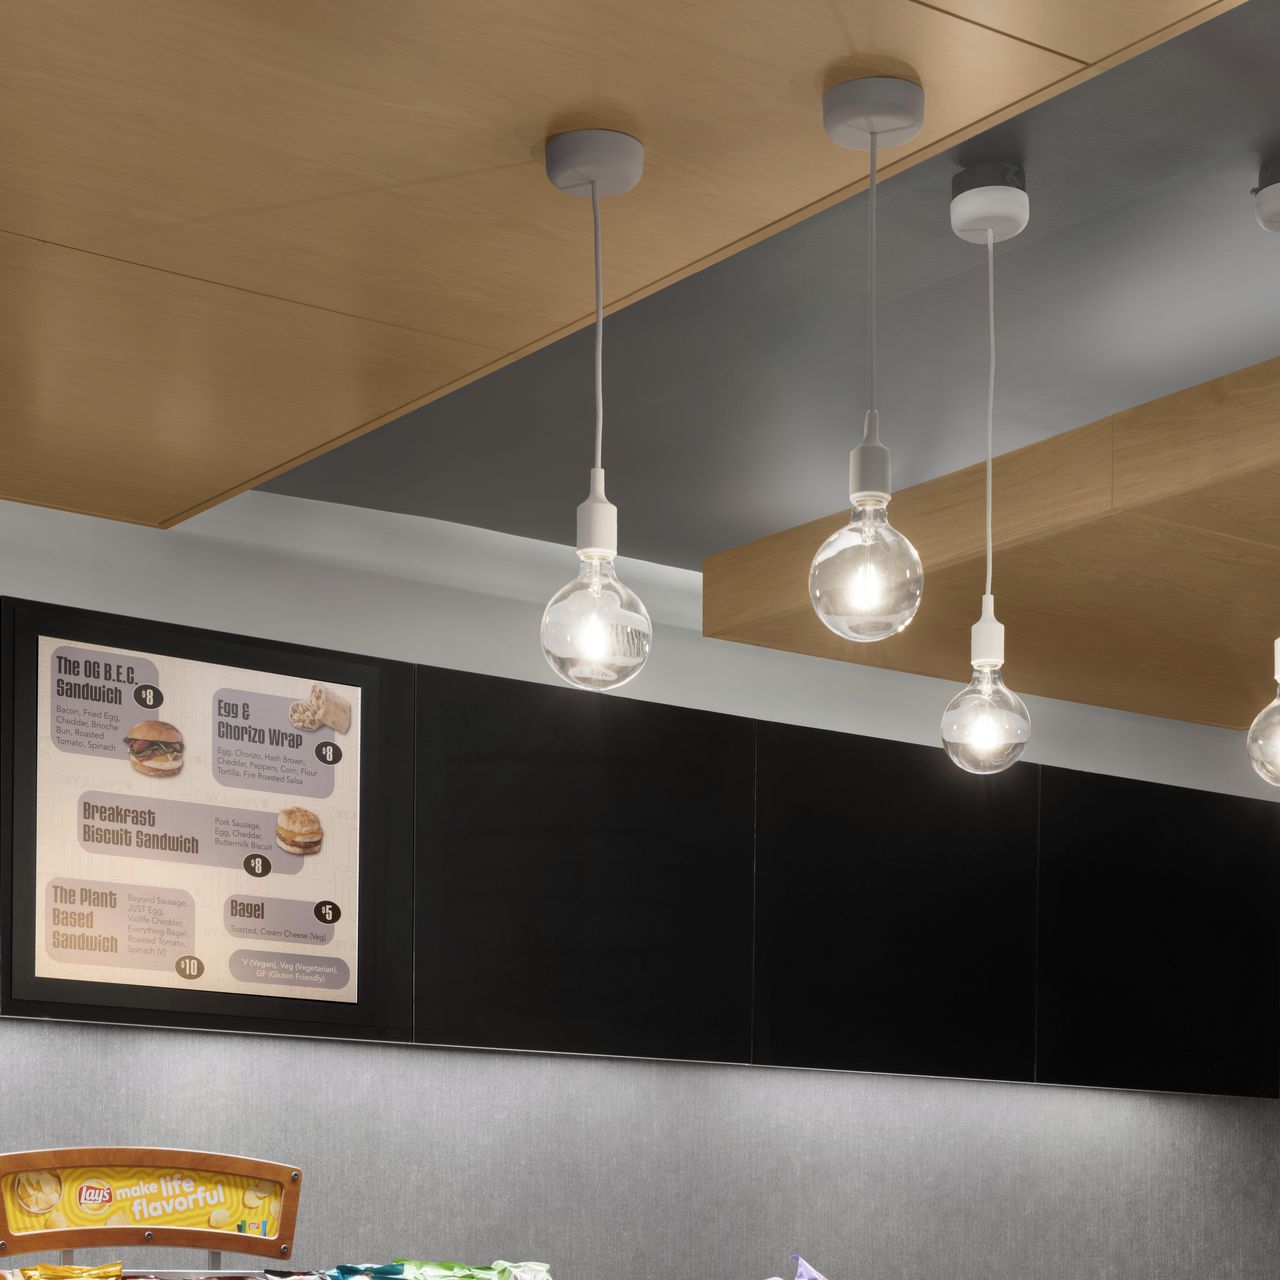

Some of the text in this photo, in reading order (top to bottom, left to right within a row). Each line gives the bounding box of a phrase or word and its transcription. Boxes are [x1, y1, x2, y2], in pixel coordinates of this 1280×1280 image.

[56, 656, 138, 685] The OG B.E.C.
[56, 679, 122, 705] Sandwich
[142, 689, 154, 705] $8
[56, 705, 120, 722] Bacon, Fried Egg,
[218, 699, 250, 720] Egg &
[56, 716, 119, 731] Cheddar, Brioche
[56, 727, 104, 740] Bun, Roasted
[218, 721, 303, 749] Chorizo Wrap
[56, 737, 116, 752] Tomato, Spinach
[218, 747, 306, 766] Egg, Chorizo, Hash Brown,
[322, 746, 333, 762] $8
[217, 767, 303, 785] Tortilla, Fire Roasted Salsa
[83, 801, 155, 827] Breakfast
[215, 818, 262, 831] Pork Sausage,
[83, 824, 199, 854] Biscuit Sandwich
[215, 838, 272, 851] Buttermilk Biscuit
[251, 858, 262, 874] $8
[53, 885, 117, 909] The Plant
[231, 899, 265, 919] Bagel
[321, 905, 332, 920] $5
[53, 908, 94, 929] Based
[53, 930, 118, 953] Sandwich
[180, 959, 197, 976] $10
[80, 1185, 112, 1203] Lay's
[116, 1174, 195, 1200] make life
[132, 1184, 225, 1221] flavorful
